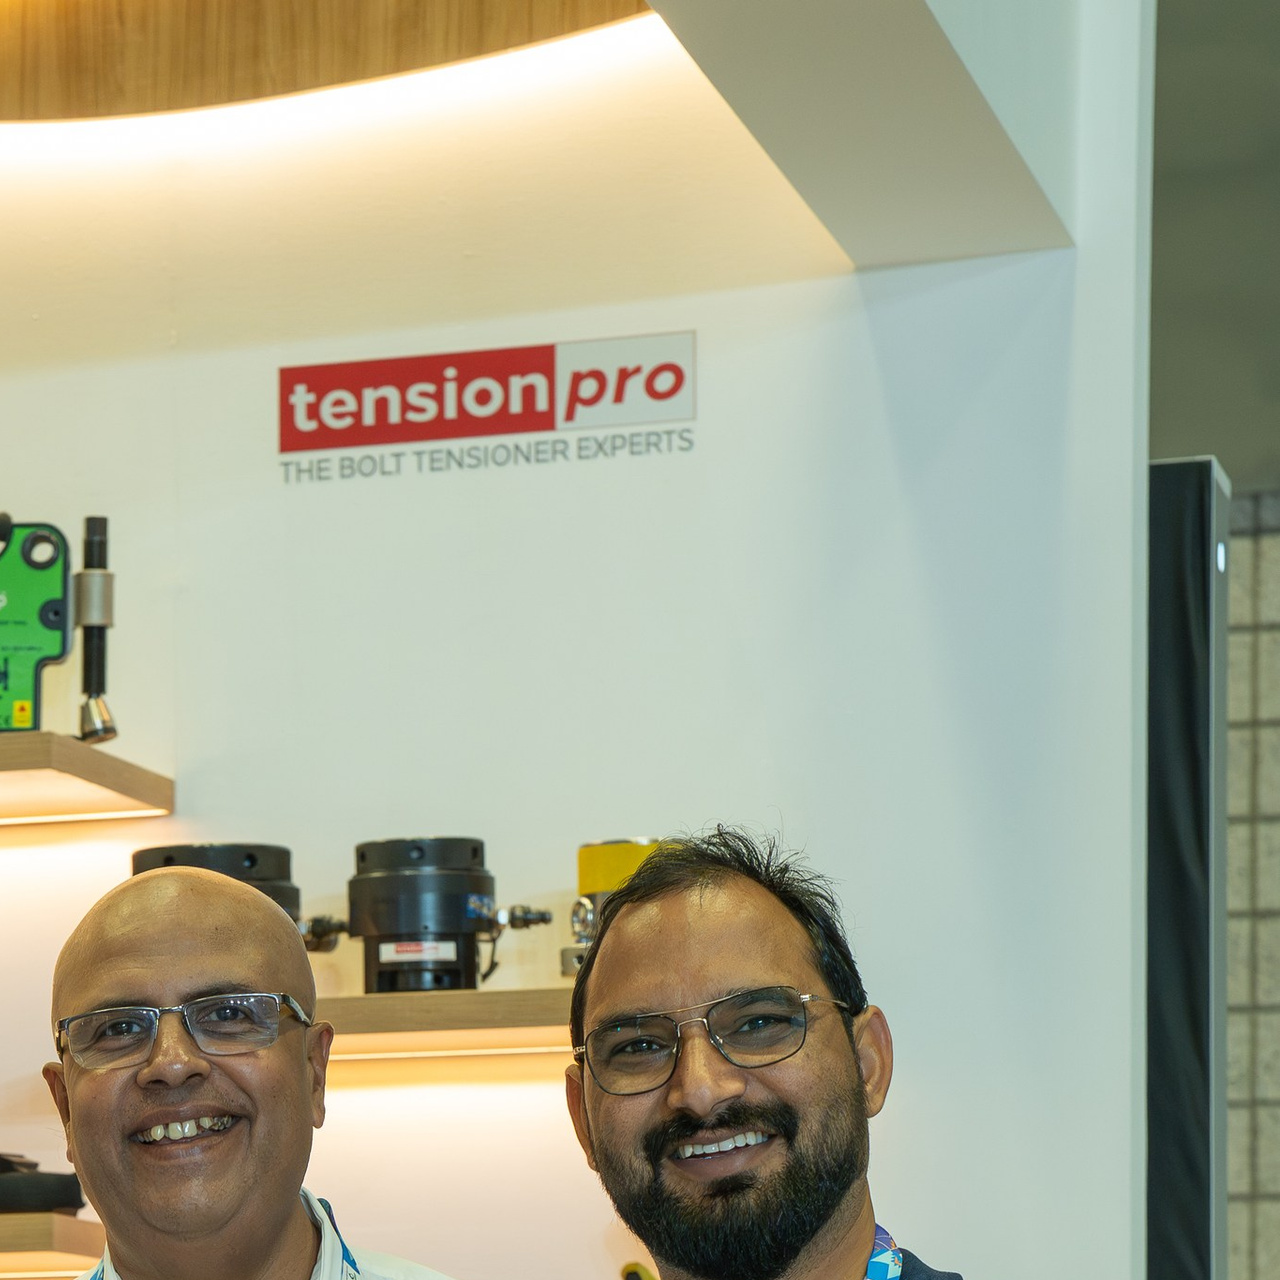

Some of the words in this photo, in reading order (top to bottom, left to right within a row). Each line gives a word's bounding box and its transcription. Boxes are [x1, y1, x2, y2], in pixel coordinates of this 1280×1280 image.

[289, 366, 550, 432] tension
[564, 361, 685, 422] pro
[280, 458, 332, 485] THE
[339, 451, 405, 480] BOLT
[413, 439, 570, 473] TENSIONER
[577, 429, 694, 460] EXPERTS
